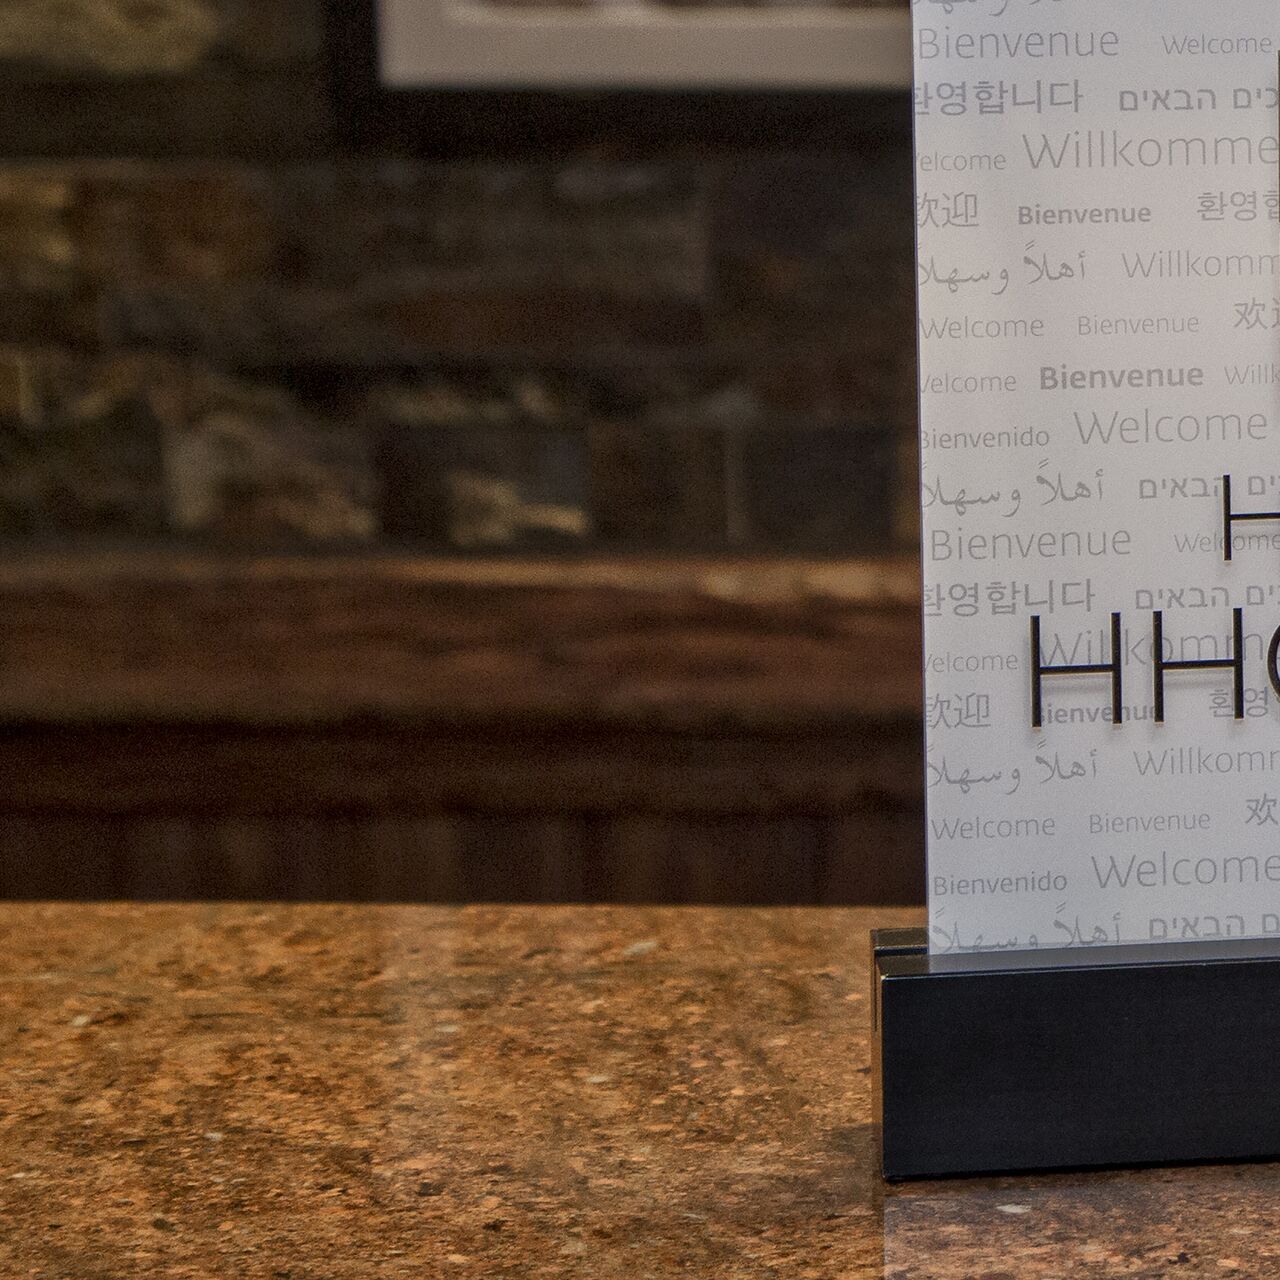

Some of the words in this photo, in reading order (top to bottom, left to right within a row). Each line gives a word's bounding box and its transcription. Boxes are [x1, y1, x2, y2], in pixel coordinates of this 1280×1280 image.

[918, 26, 1120, 60] Bienvenue
[1161, 33, 1273, 55] Welcome
[1017, 204, 1152, 226] Bienvenue
[918, 315, 1045, 341] Welcome
[1039, 364, 1205, 391] Bienvenue
[1072, 410, 1269, 445] Welcome
[930, 528, 1132, 561] Bienvenue
[930, 816, 1056, 841] Welcome
[932, 870, 1068, 898] Bienvenido
